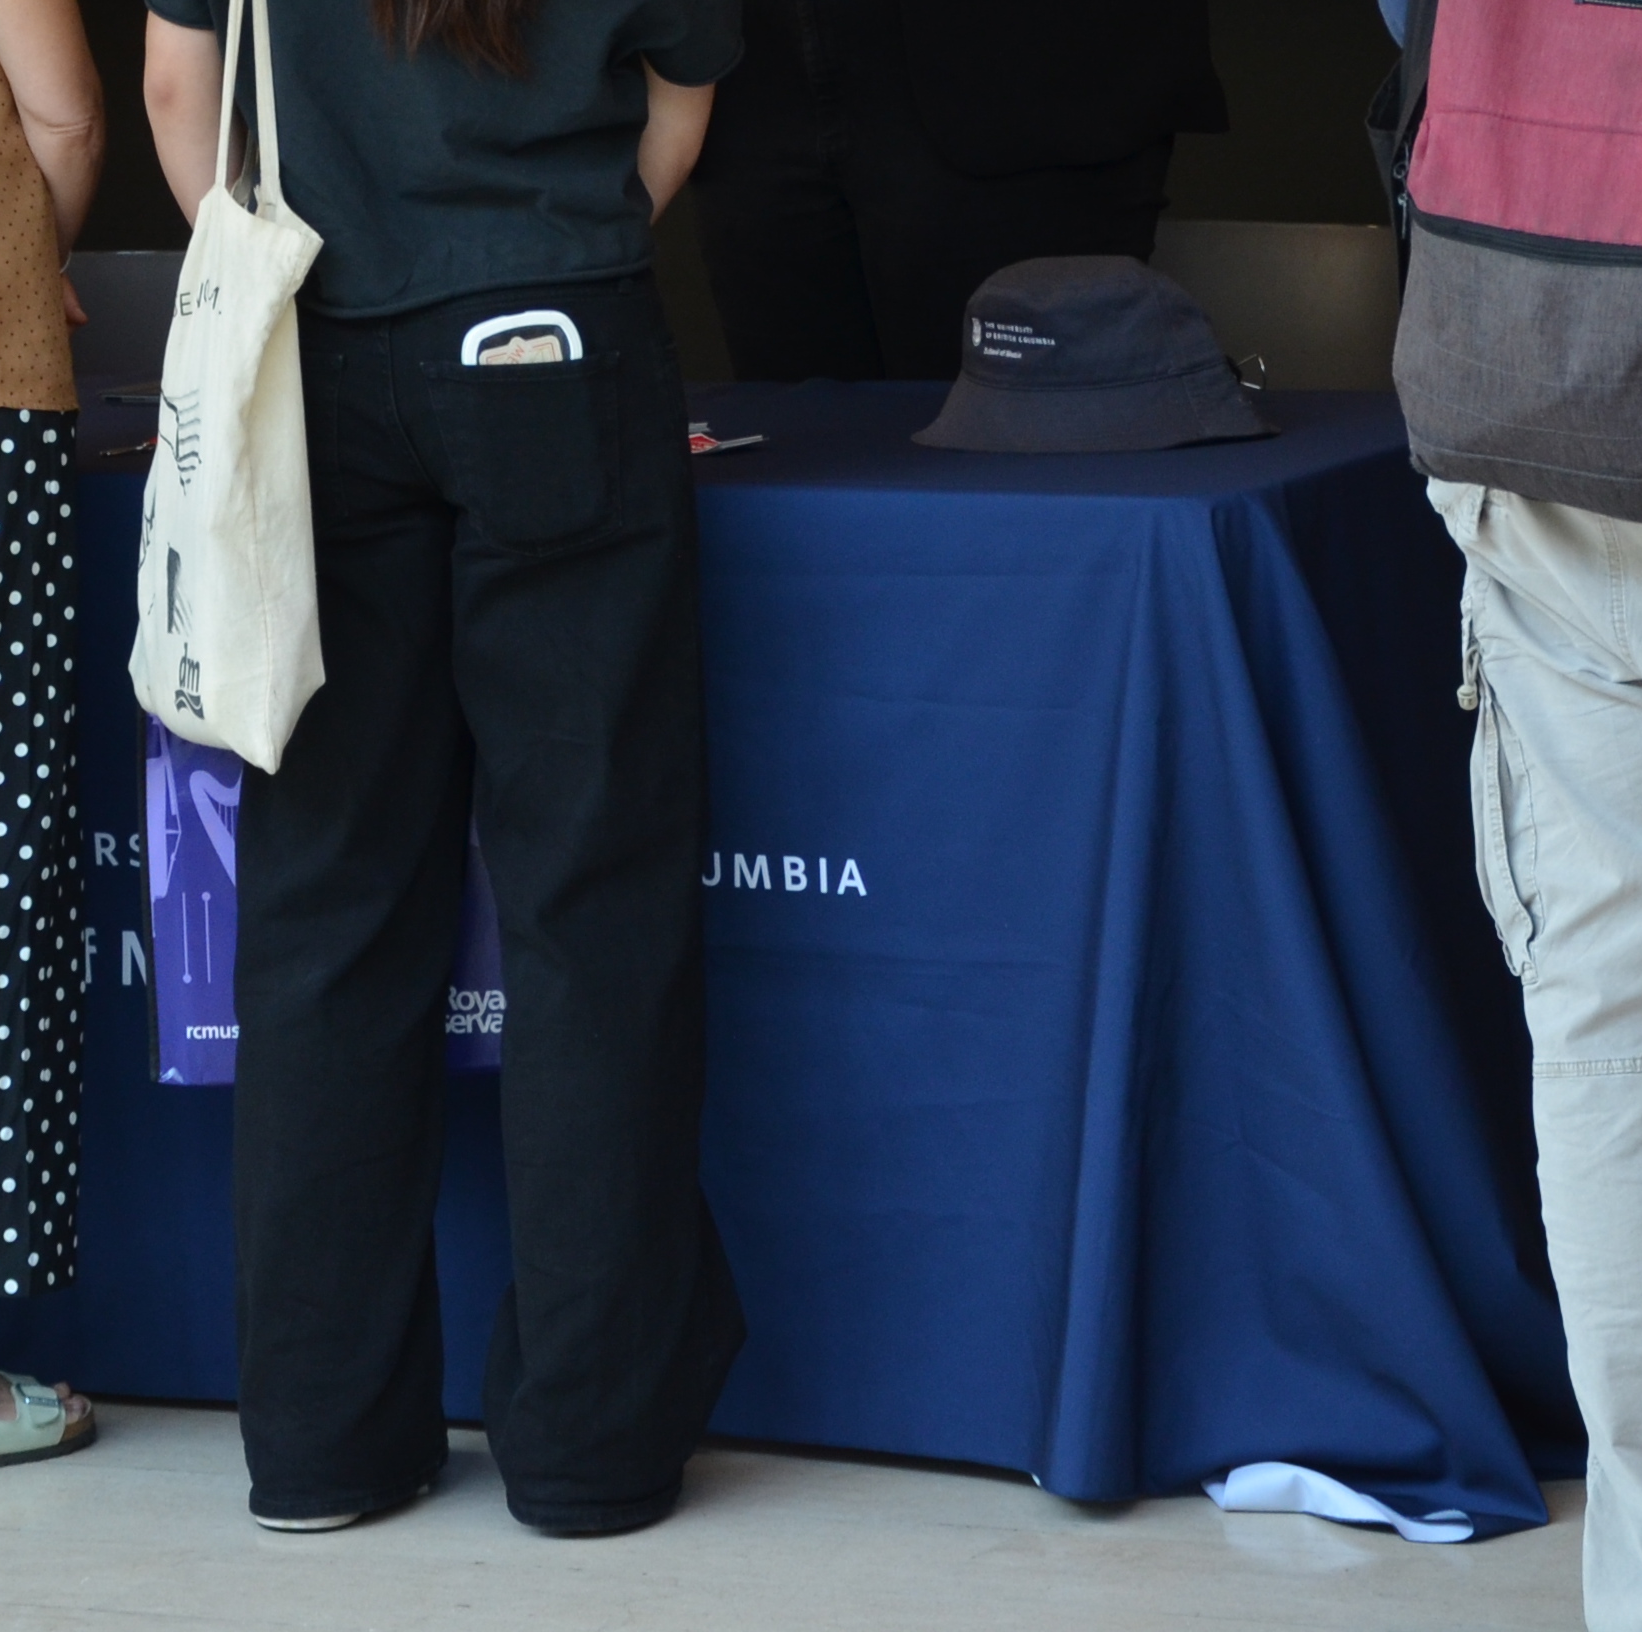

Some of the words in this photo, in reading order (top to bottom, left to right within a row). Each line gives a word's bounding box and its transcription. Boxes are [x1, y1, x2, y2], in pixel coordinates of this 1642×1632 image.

[179, 642, 200, 693] dm
[702, 851, 867, 897] UMBIA
[186, 1025, 239, 1039] rcmus
